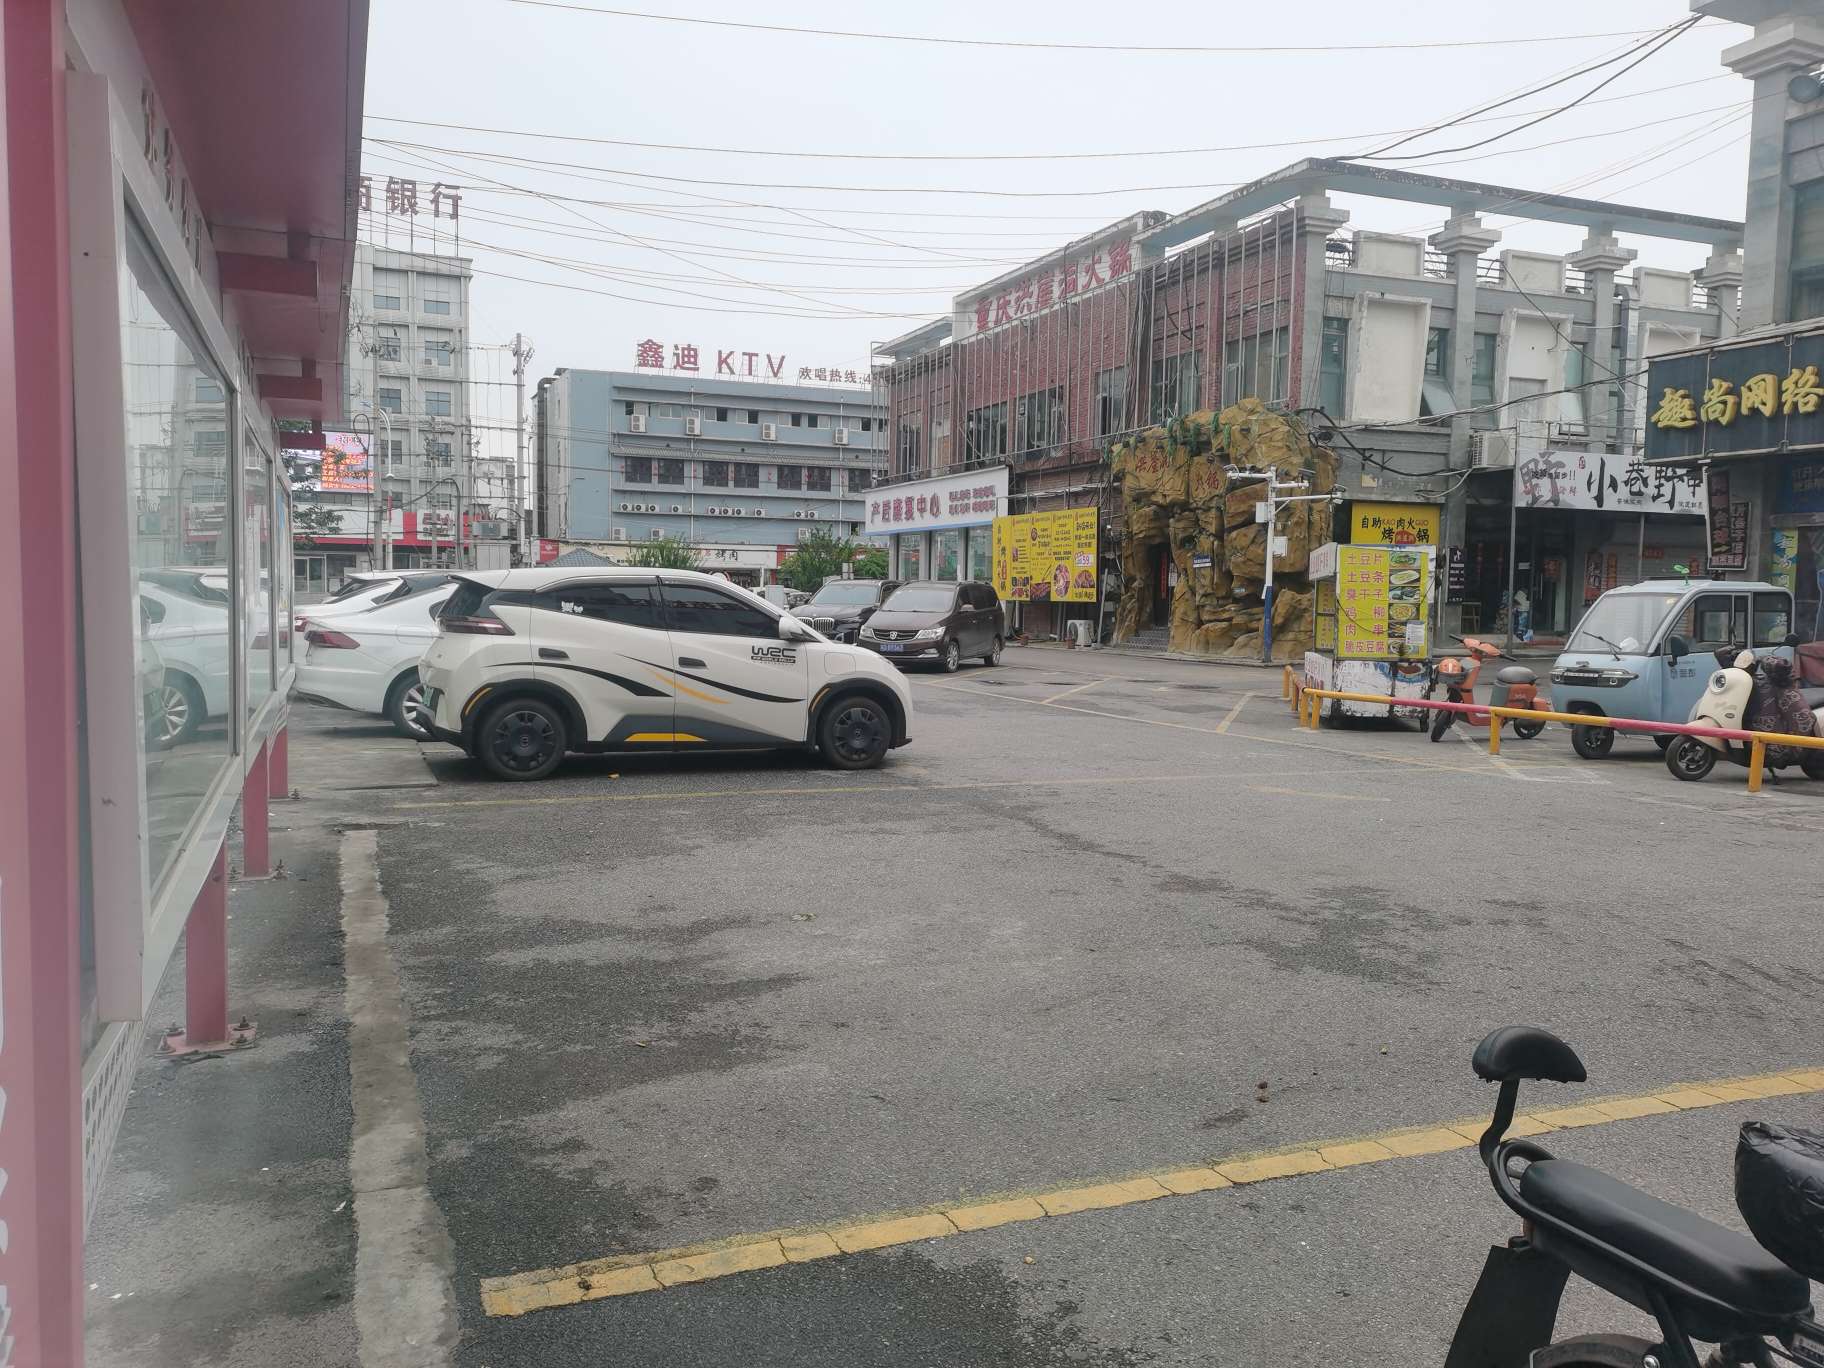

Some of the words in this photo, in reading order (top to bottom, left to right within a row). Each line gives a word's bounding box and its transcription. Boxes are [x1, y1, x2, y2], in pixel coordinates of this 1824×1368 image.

[637, 338, 699, 372] 鑫迪
[717, 350, 786, 378] KTV
[1651, 365, 1824, 429] 趣尚网络
[1361, 515, 1382, 529] 自助
[1345, 552, 1384, 568] 土豆片
[1346, 570, 1385, 583] 土豆条
[752, 645, 797, 658] WRC
